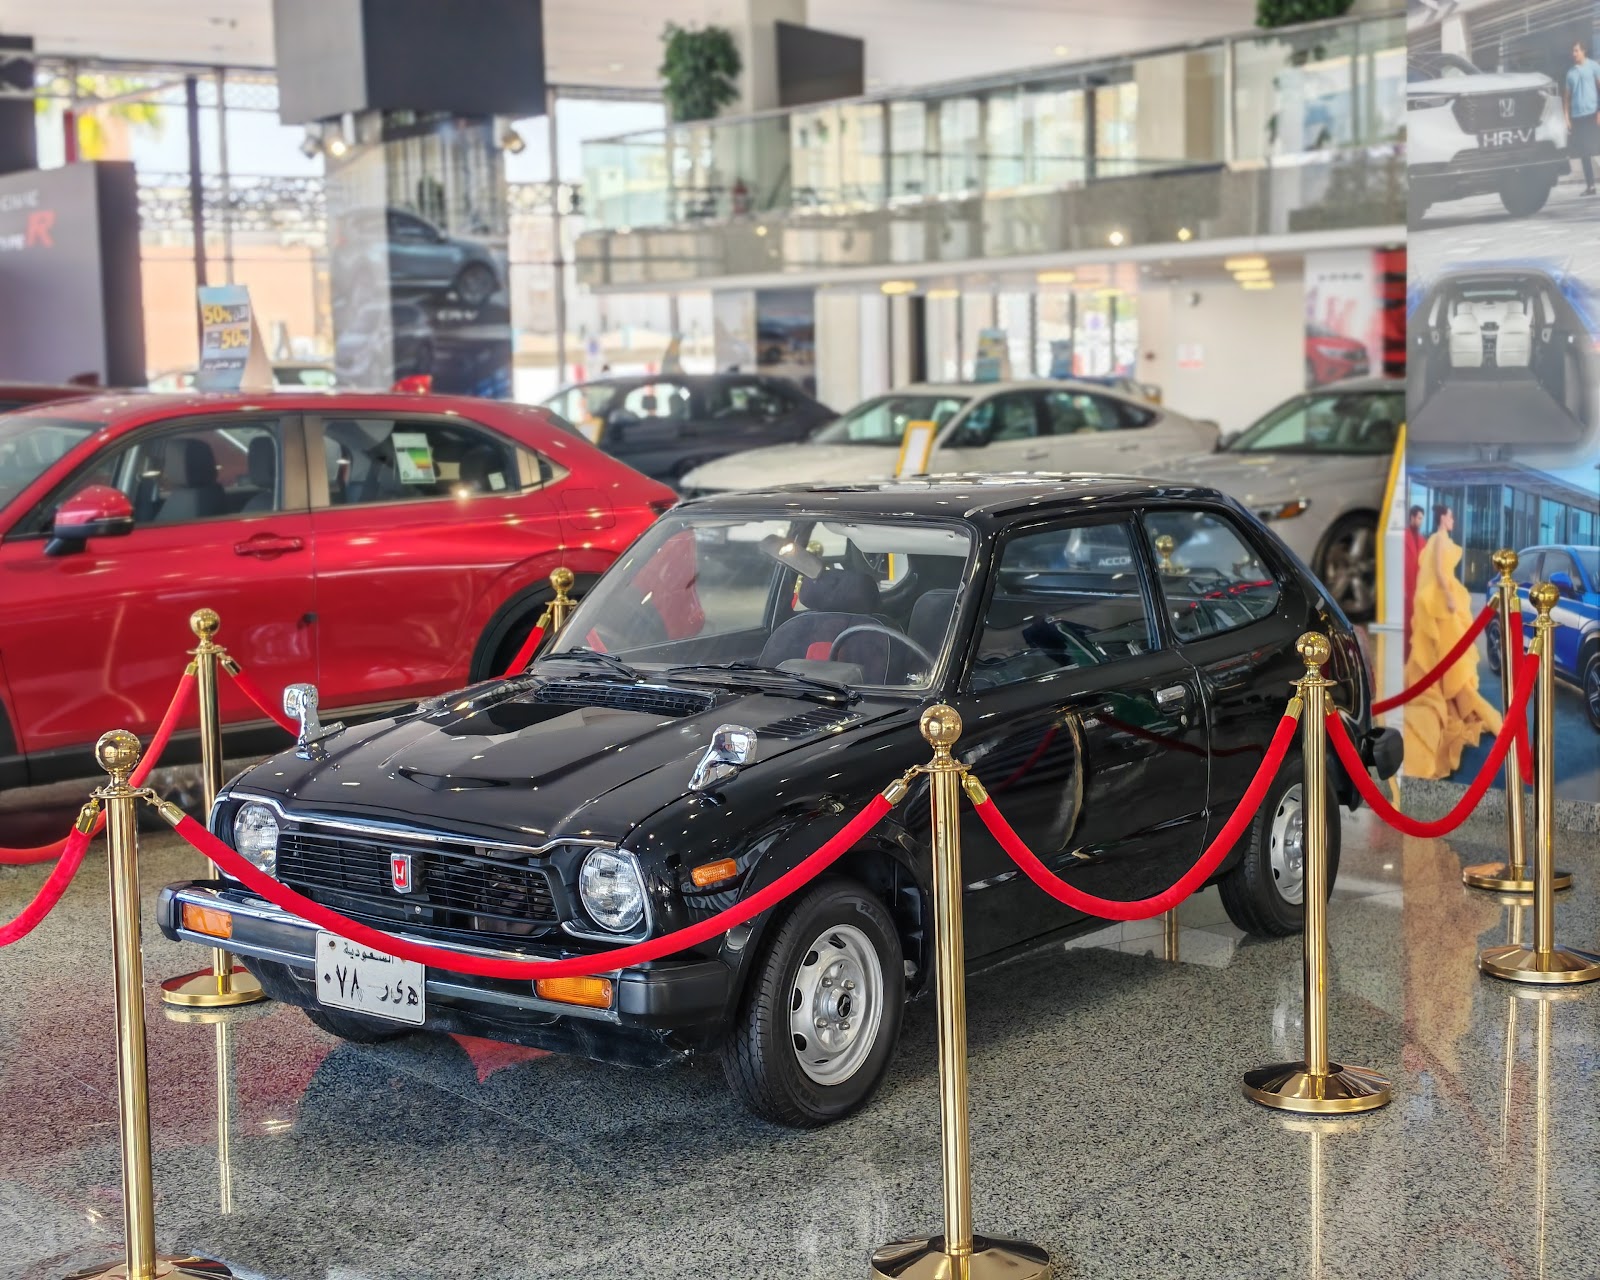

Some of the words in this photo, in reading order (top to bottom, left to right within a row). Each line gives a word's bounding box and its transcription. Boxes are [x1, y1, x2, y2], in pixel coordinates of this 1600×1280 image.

[1483, 128, 1533, 147] HR-V
[27, 210, 56, 249] R
[204, 304, 232, 325] 50%
[222, 327, 248, 350] 50%
[343, 942, 394, 964] السعودية
